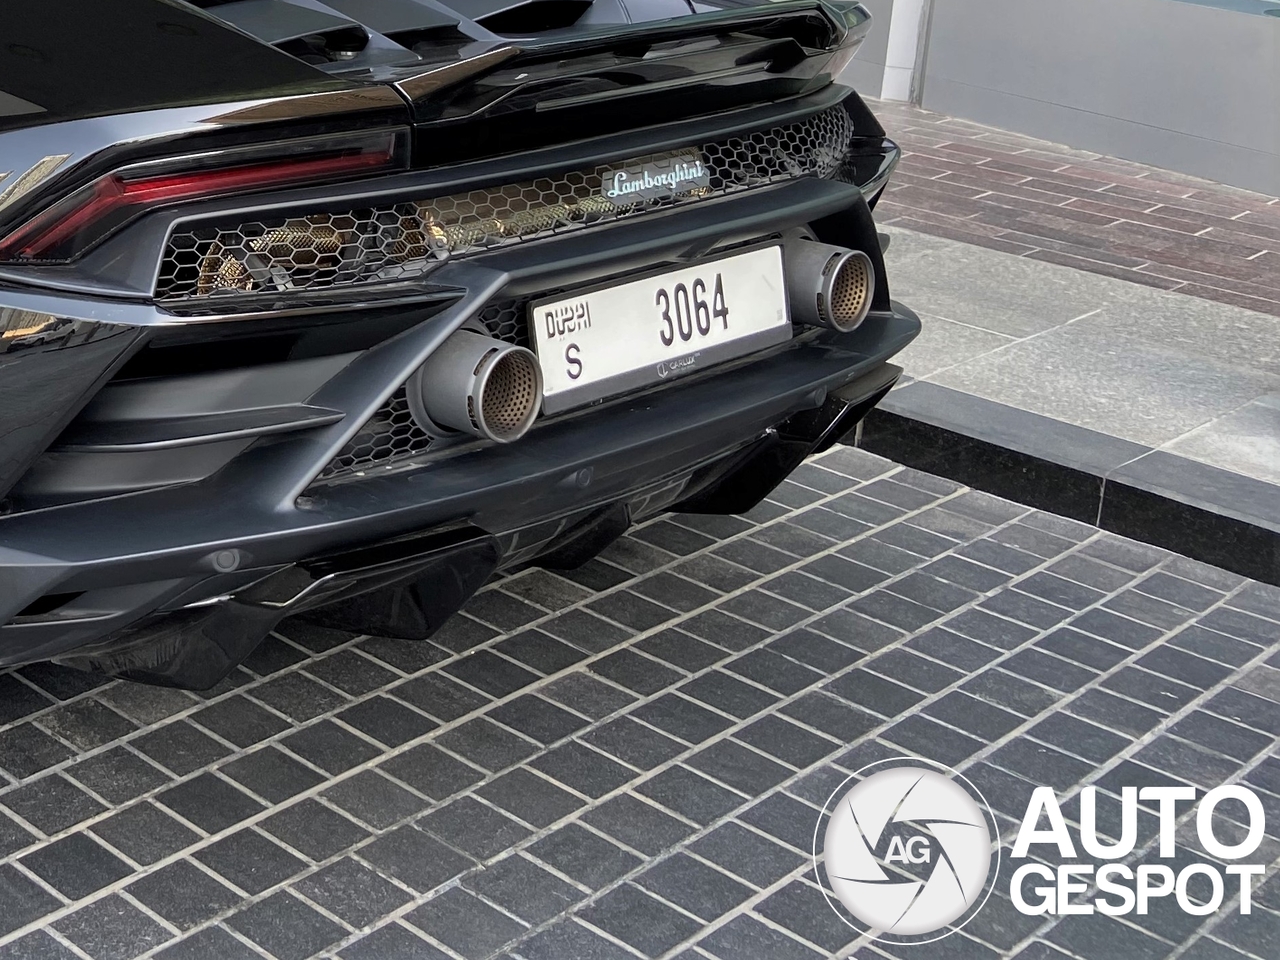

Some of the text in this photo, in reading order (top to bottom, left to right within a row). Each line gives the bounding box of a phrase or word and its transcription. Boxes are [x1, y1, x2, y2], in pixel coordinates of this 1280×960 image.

[607, 160, 704, 197] Lamborghini
[565, 272, 729, 380] S 3064
